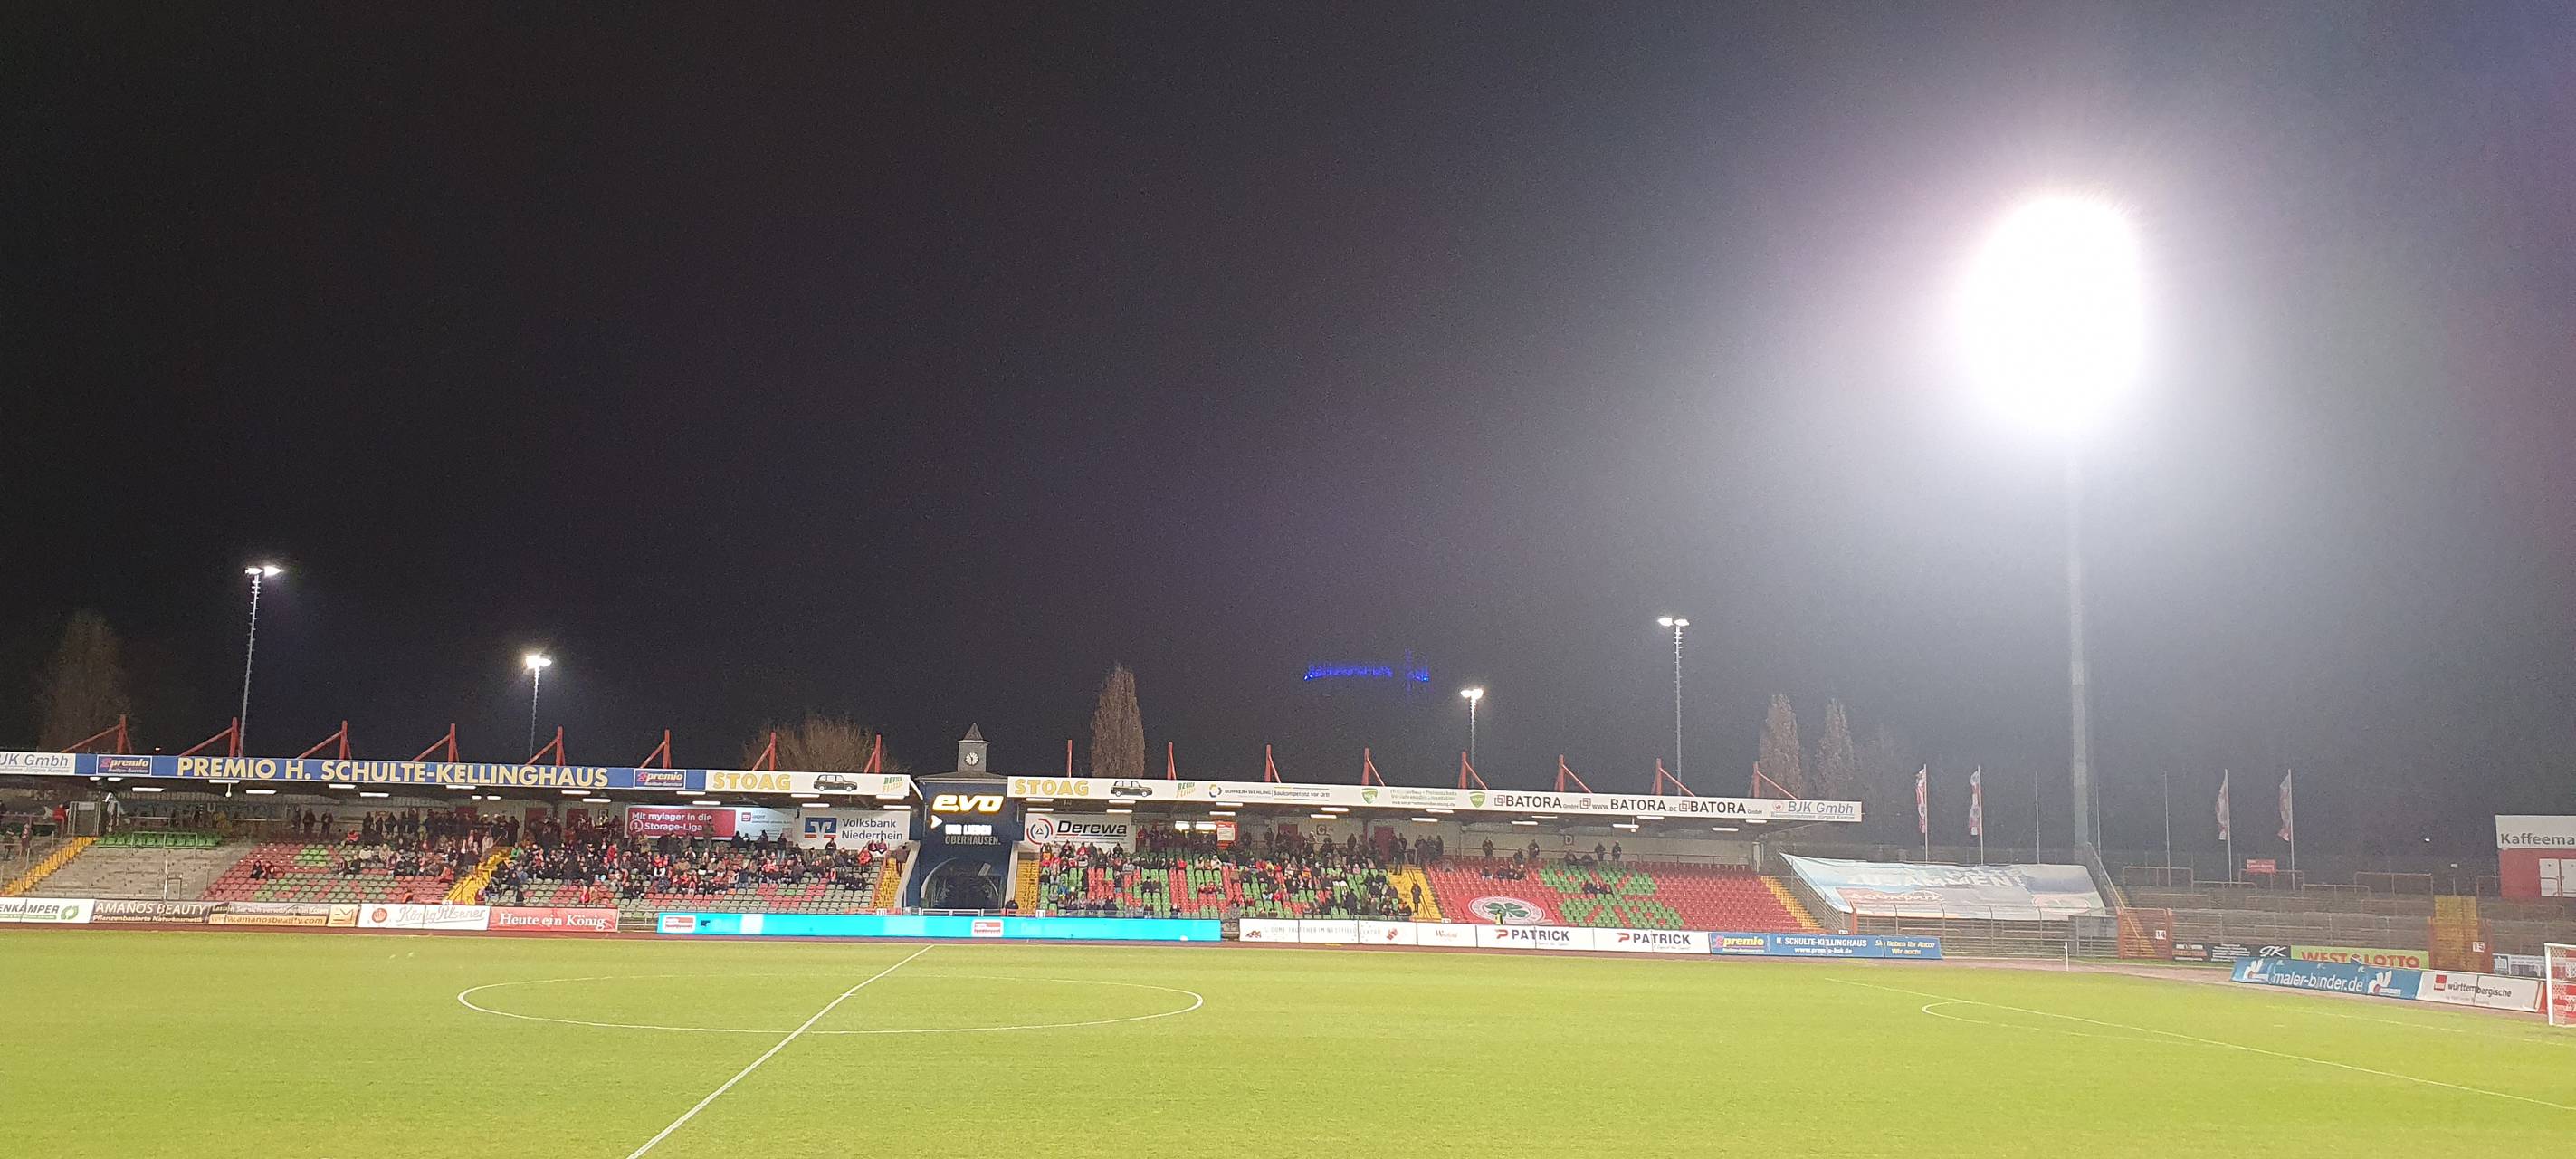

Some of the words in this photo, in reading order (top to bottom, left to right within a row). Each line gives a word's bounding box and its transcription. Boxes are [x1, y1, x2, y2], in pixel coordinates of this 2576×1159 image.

[0, 753, 19, 765] JK
[24, 754, 68, 766] Gmbh
[177, 757, 276, 780] PREMIO
[285, 760, 311, 780] H.
[320, 761, 609, 787] SCHULTE-KELLINGHAUS
[645, 771, 683, 781] premio
[713, 772, 791, 790] STOAG
[1015, 778, 1090, 797] STOAG
[932, 794, 1004, 812] evo
[1505, 795, 1562, 809] BATORA
[1610, 799, 1666, 811] BATORA
[1690, 801, 1747, 814] BATORA
[1788, 801, 1811, 813] BJK
[1817, 802, 1854, 814] Gmbh
[632, 812, 646, 820] Mit
[648, 812, 686, 822] mylager
[687, 812, 696, 820] in
[842, 818, 897, 829] Volksbank
[644, 822, 703, 832] Storage-Liga
[1057, 820, 1128, 834] Derewa
[841, 831, 903, 840] Niederrhein
[945, 835, 1001, 845] OBERHAUSEN.
[2500, 832, 2575, 846] Kaffeema
[95, 902, 154, 914] AMANOS
[156, 903, 206, 915] BEAUTY
[501, 913, 539, 925] Heute
[540, 914, 562, 926] ein
[567, 914, 607, 930] König
[1512, 929, 1570, 942] PATRICK
[1633, 932, 1692, 945] PATRICK
[1722, 936, 1764, 947] premio
[2474, 942, 2485, 951] 15
[2301, 950, 2349, 963] WEST
[2363, 953, 2420, 968] LOTTO
[2273, 971, 2364, 992] maler-binder.de
[2447, 981, 2513, 998] württembergische
